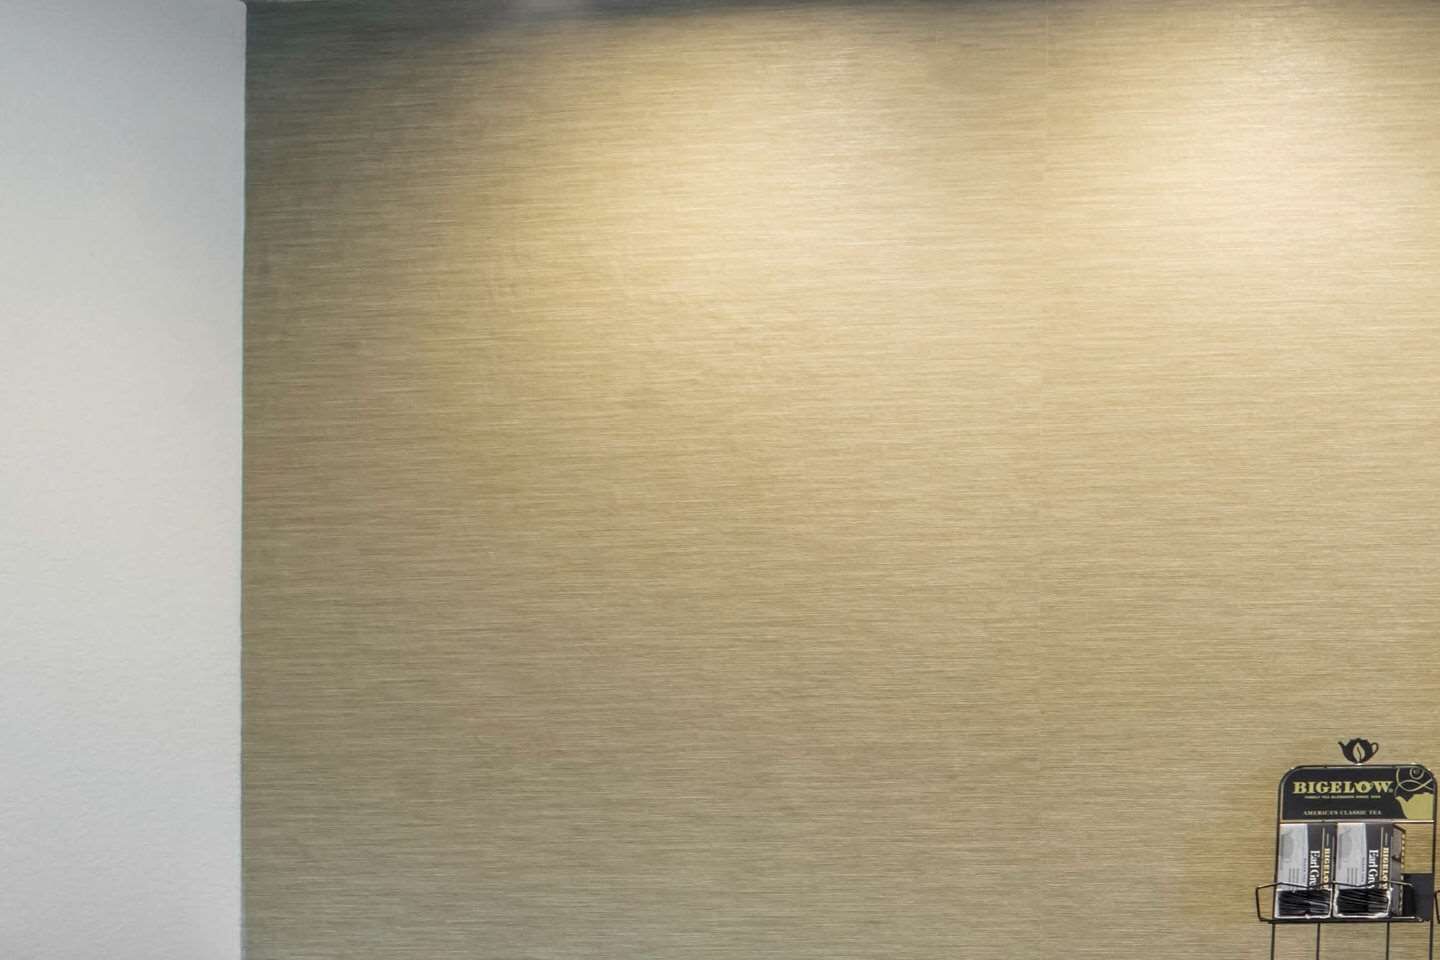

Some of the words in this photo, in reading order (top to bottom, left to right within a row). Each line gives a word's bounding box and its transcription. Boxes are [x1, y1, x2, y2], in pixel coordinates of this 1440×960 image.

[1293, 781, 1393, 794] BIGELOW
[1310, 850, 1320, 868] Earl
[1368, 849, 1379, 867] Earl
[1309, 869, 1320, 889] Gre
